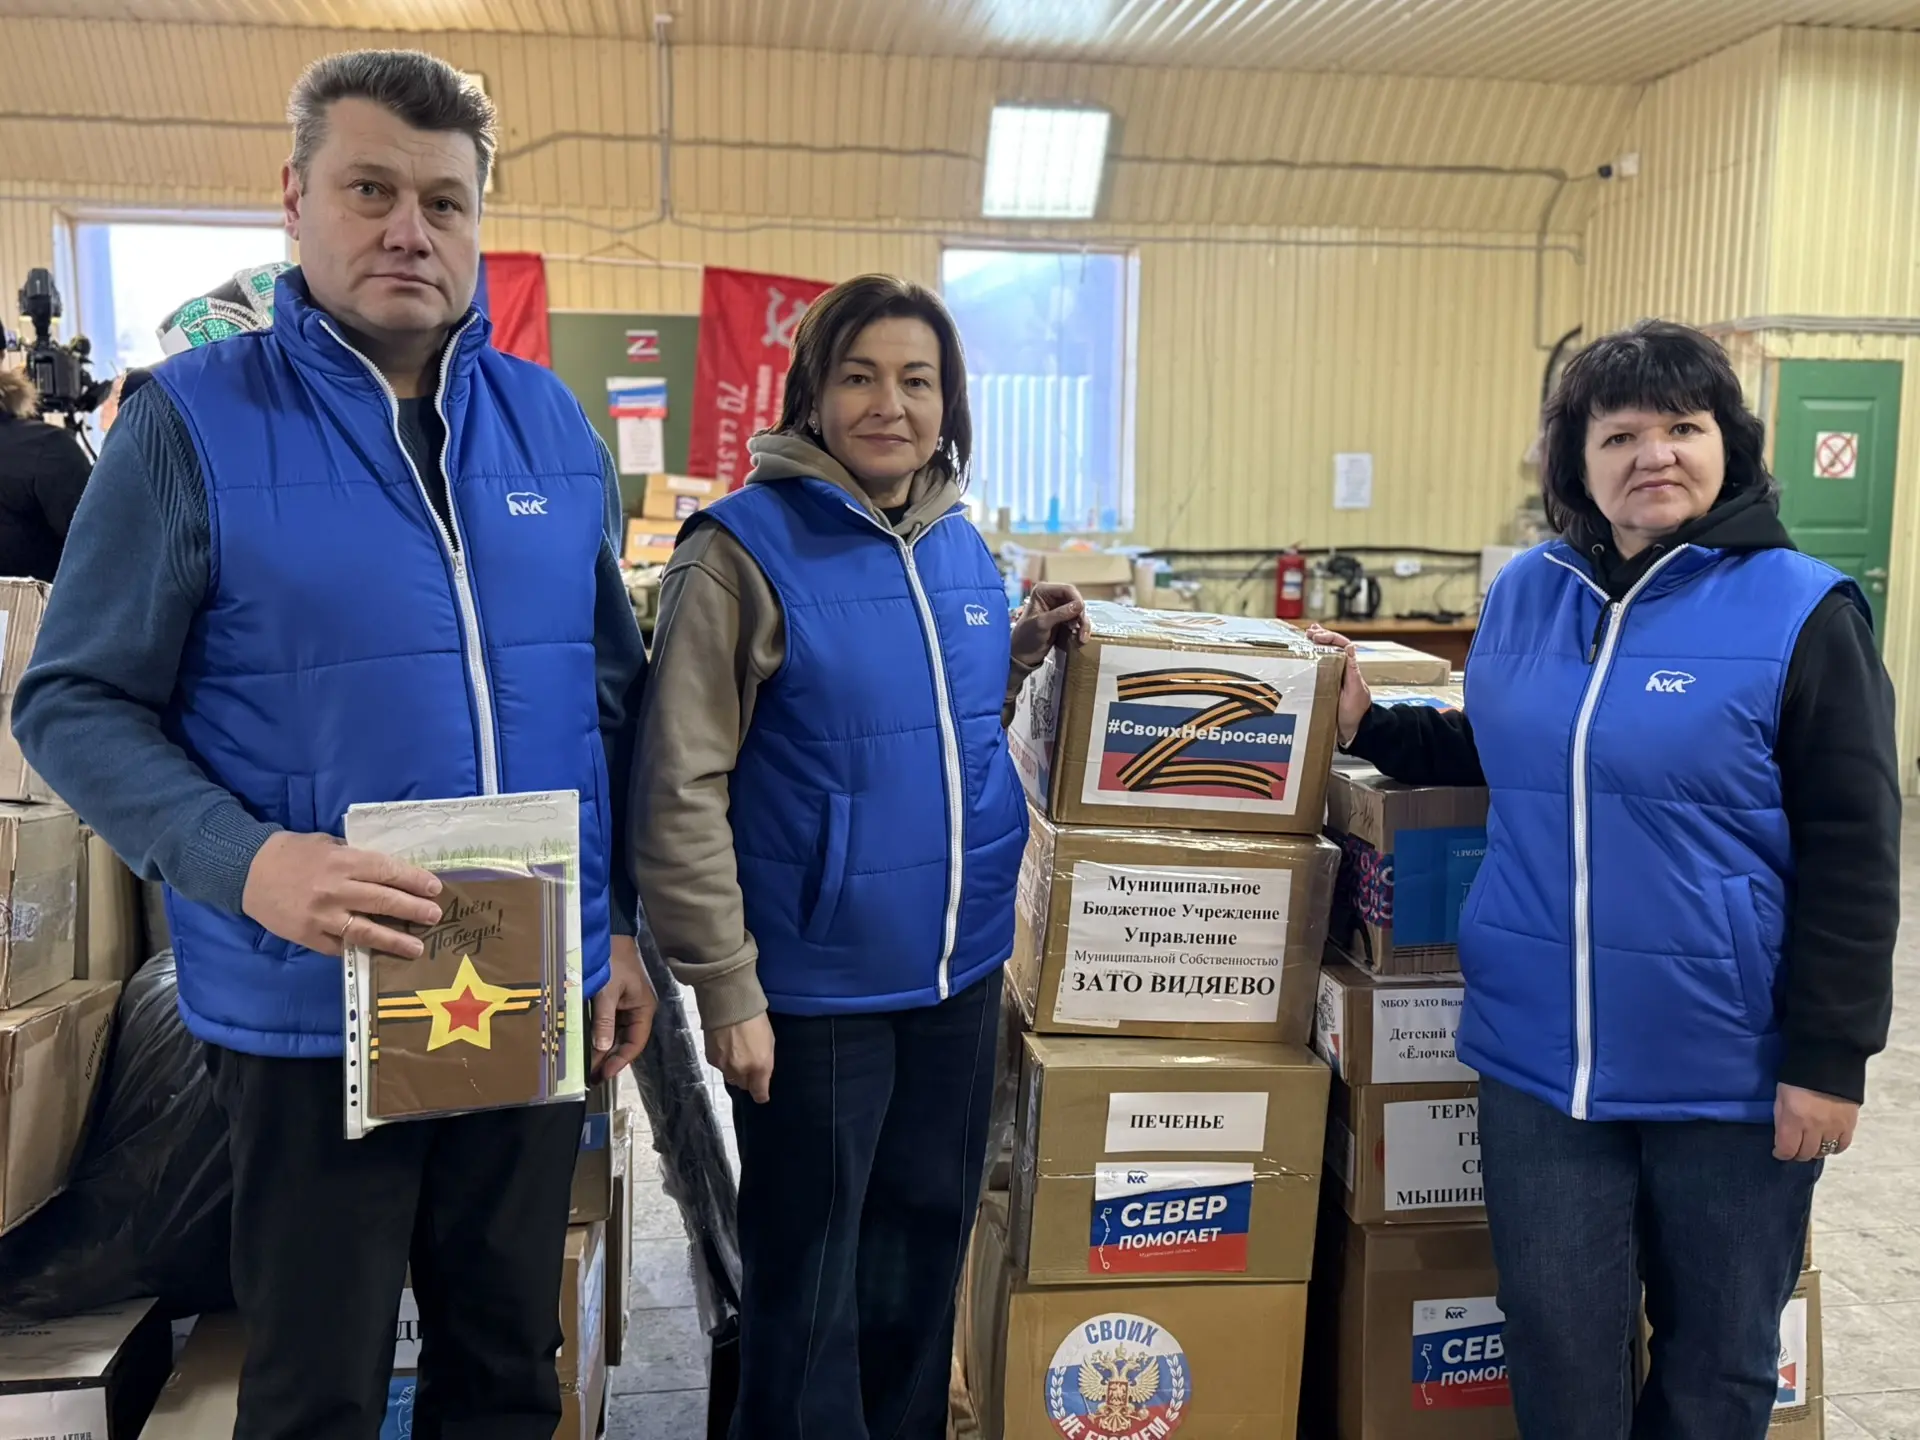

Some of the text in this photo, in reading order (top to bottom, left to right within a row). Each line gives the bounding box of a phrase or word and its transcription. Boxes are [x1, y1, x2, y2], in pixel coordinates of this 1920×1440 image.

[1107, 718, 1293, 745] #СвоихНеБросаем
[1107, 875, 1261, 896] Муниципальное
[440, 896, 493, 923] Днём
[1082, 901, 1280, 922] Бюджетное Учреждение
[421, 909, 504, 961] Победы!
[1124, 926, 1238, 947] Управление
[1074, 949, 1279, 967] Муниципальной Собственностью
[1072, 972, 1276, 999] ЗАТО ВИДЯЕВО
[1380, 997, 1464, 1009] МБОУ ЗАТО Видя
[1389, 1028, 1447, 1042] Детский
[1398, 1044, 1456, 1060] «Ёлочка
[1428, 1102, 1480, 1120] ТЕРМ
[1130, 1114, 1225, 1130] ПЕЧЕНЬЕ
[1458, 1132, 1481, 1146] ГВ
[1396, 1187, 1485, 1206] МЫШИН
[1120, 1195, 1228, 1228] СЕВЕР
[1118, 1227, 1222, 1251] ПОМОГАЕТ
[1084, 1319, 1160, 1347] СВОИХ
[1441, 1334, 1505, 1365] СЕВ
[1440, 1365, 1508, 1387] ПОМОГ
[1059, 1413, 1086, 1440] НЕ
